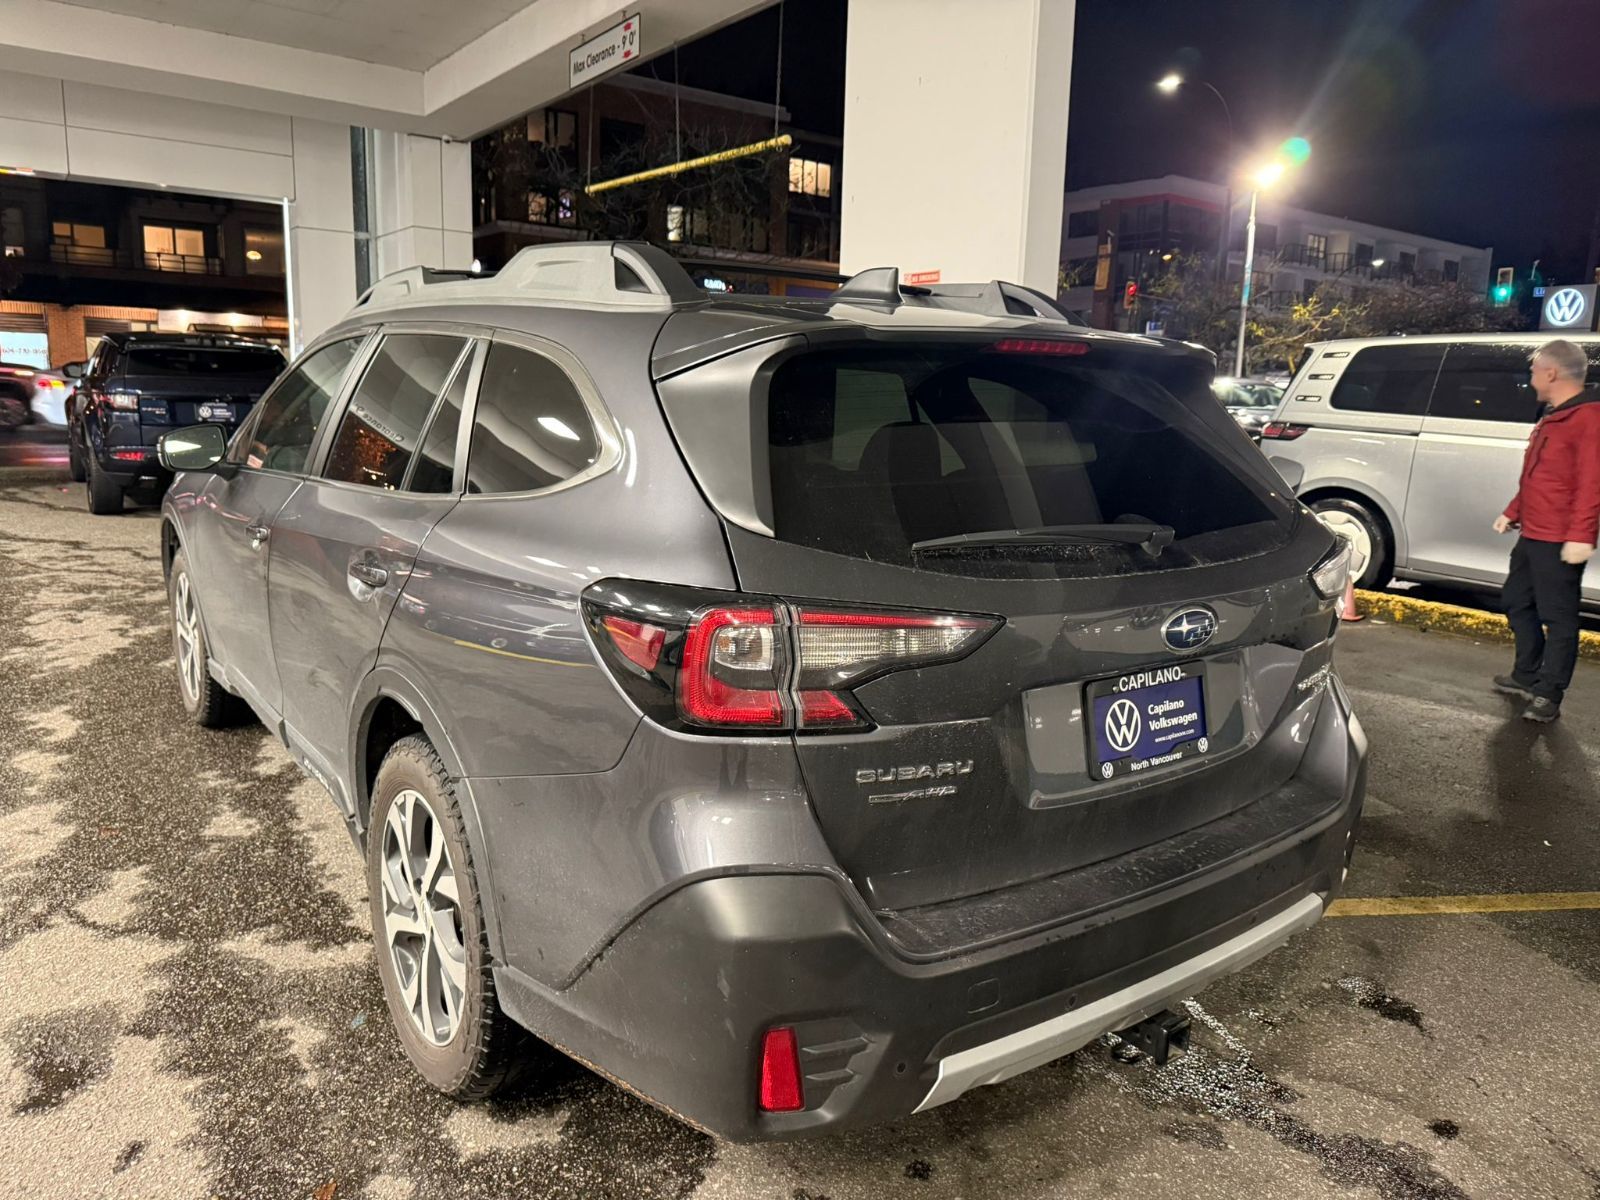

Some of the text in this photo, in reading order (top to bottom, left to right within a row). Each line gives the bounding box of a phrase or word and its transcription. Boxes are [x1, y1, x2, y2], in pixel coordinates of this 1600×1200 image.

[573, 59, 585, 74] Max
[586, 43, 616, 68] Clearance
[1119, 666, 1182, 692] CAPILANO
[1148, 699, 1185, 715] Capilano
[1105, 699, 1141, 752] VW
[1148, 712, 1198, 731] Volkswagen
[855, 759, 974, 784] SUBARU
[1131, 751, 1183, 771] North Vancouver
